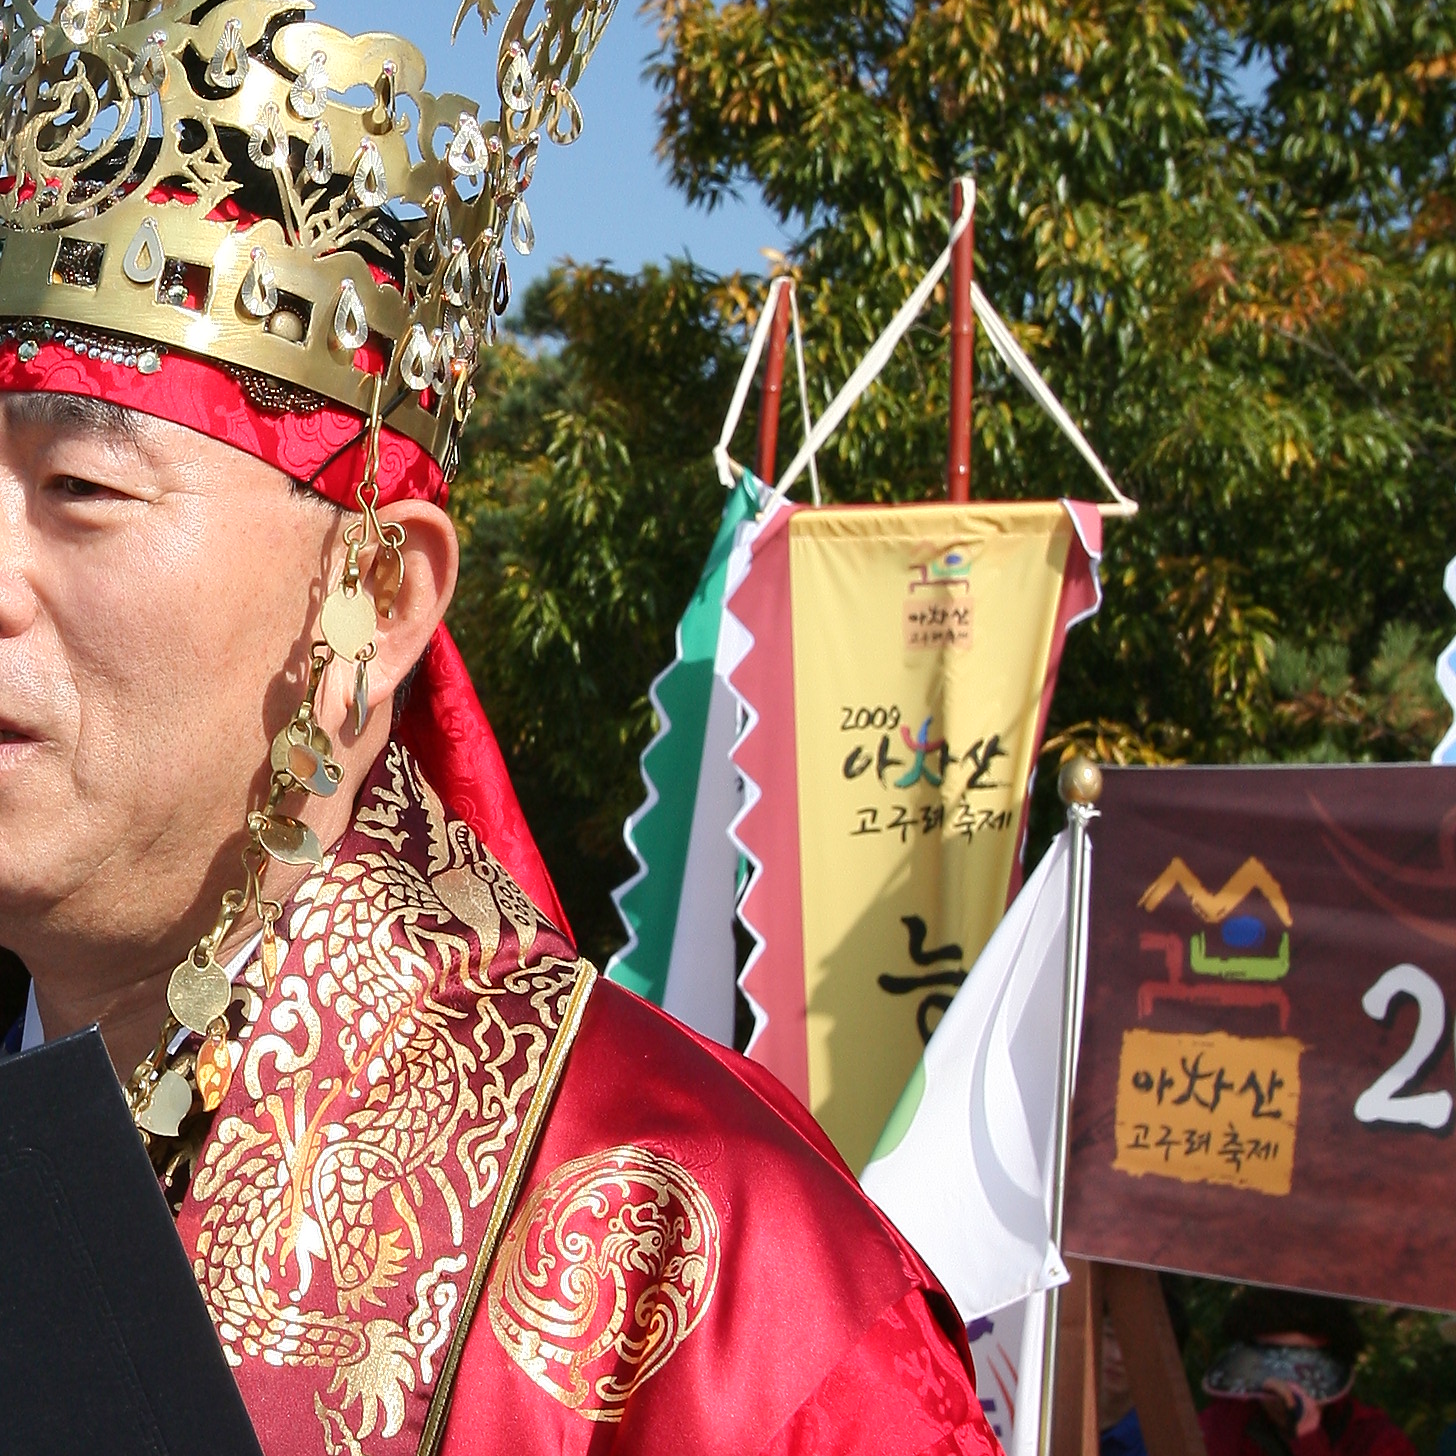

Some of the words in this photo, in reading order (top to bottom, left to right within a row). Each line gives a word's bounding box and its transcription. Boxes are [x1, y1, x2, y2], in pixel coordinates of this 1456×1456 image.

[841, 705, 901, 731] 2009
[843, 716, 1011, 789] 아차산
[850, 804, 944, 844] 고구려
[953, 792, 1013, 844] 축제
[1354, 963, 1456, 1130] 2
[1132, 1052, 1284, 1119] 아차산
[1127, 1123, 1212, 1161] 고구려
[1218, 1121, 1280, 1173] 축제
